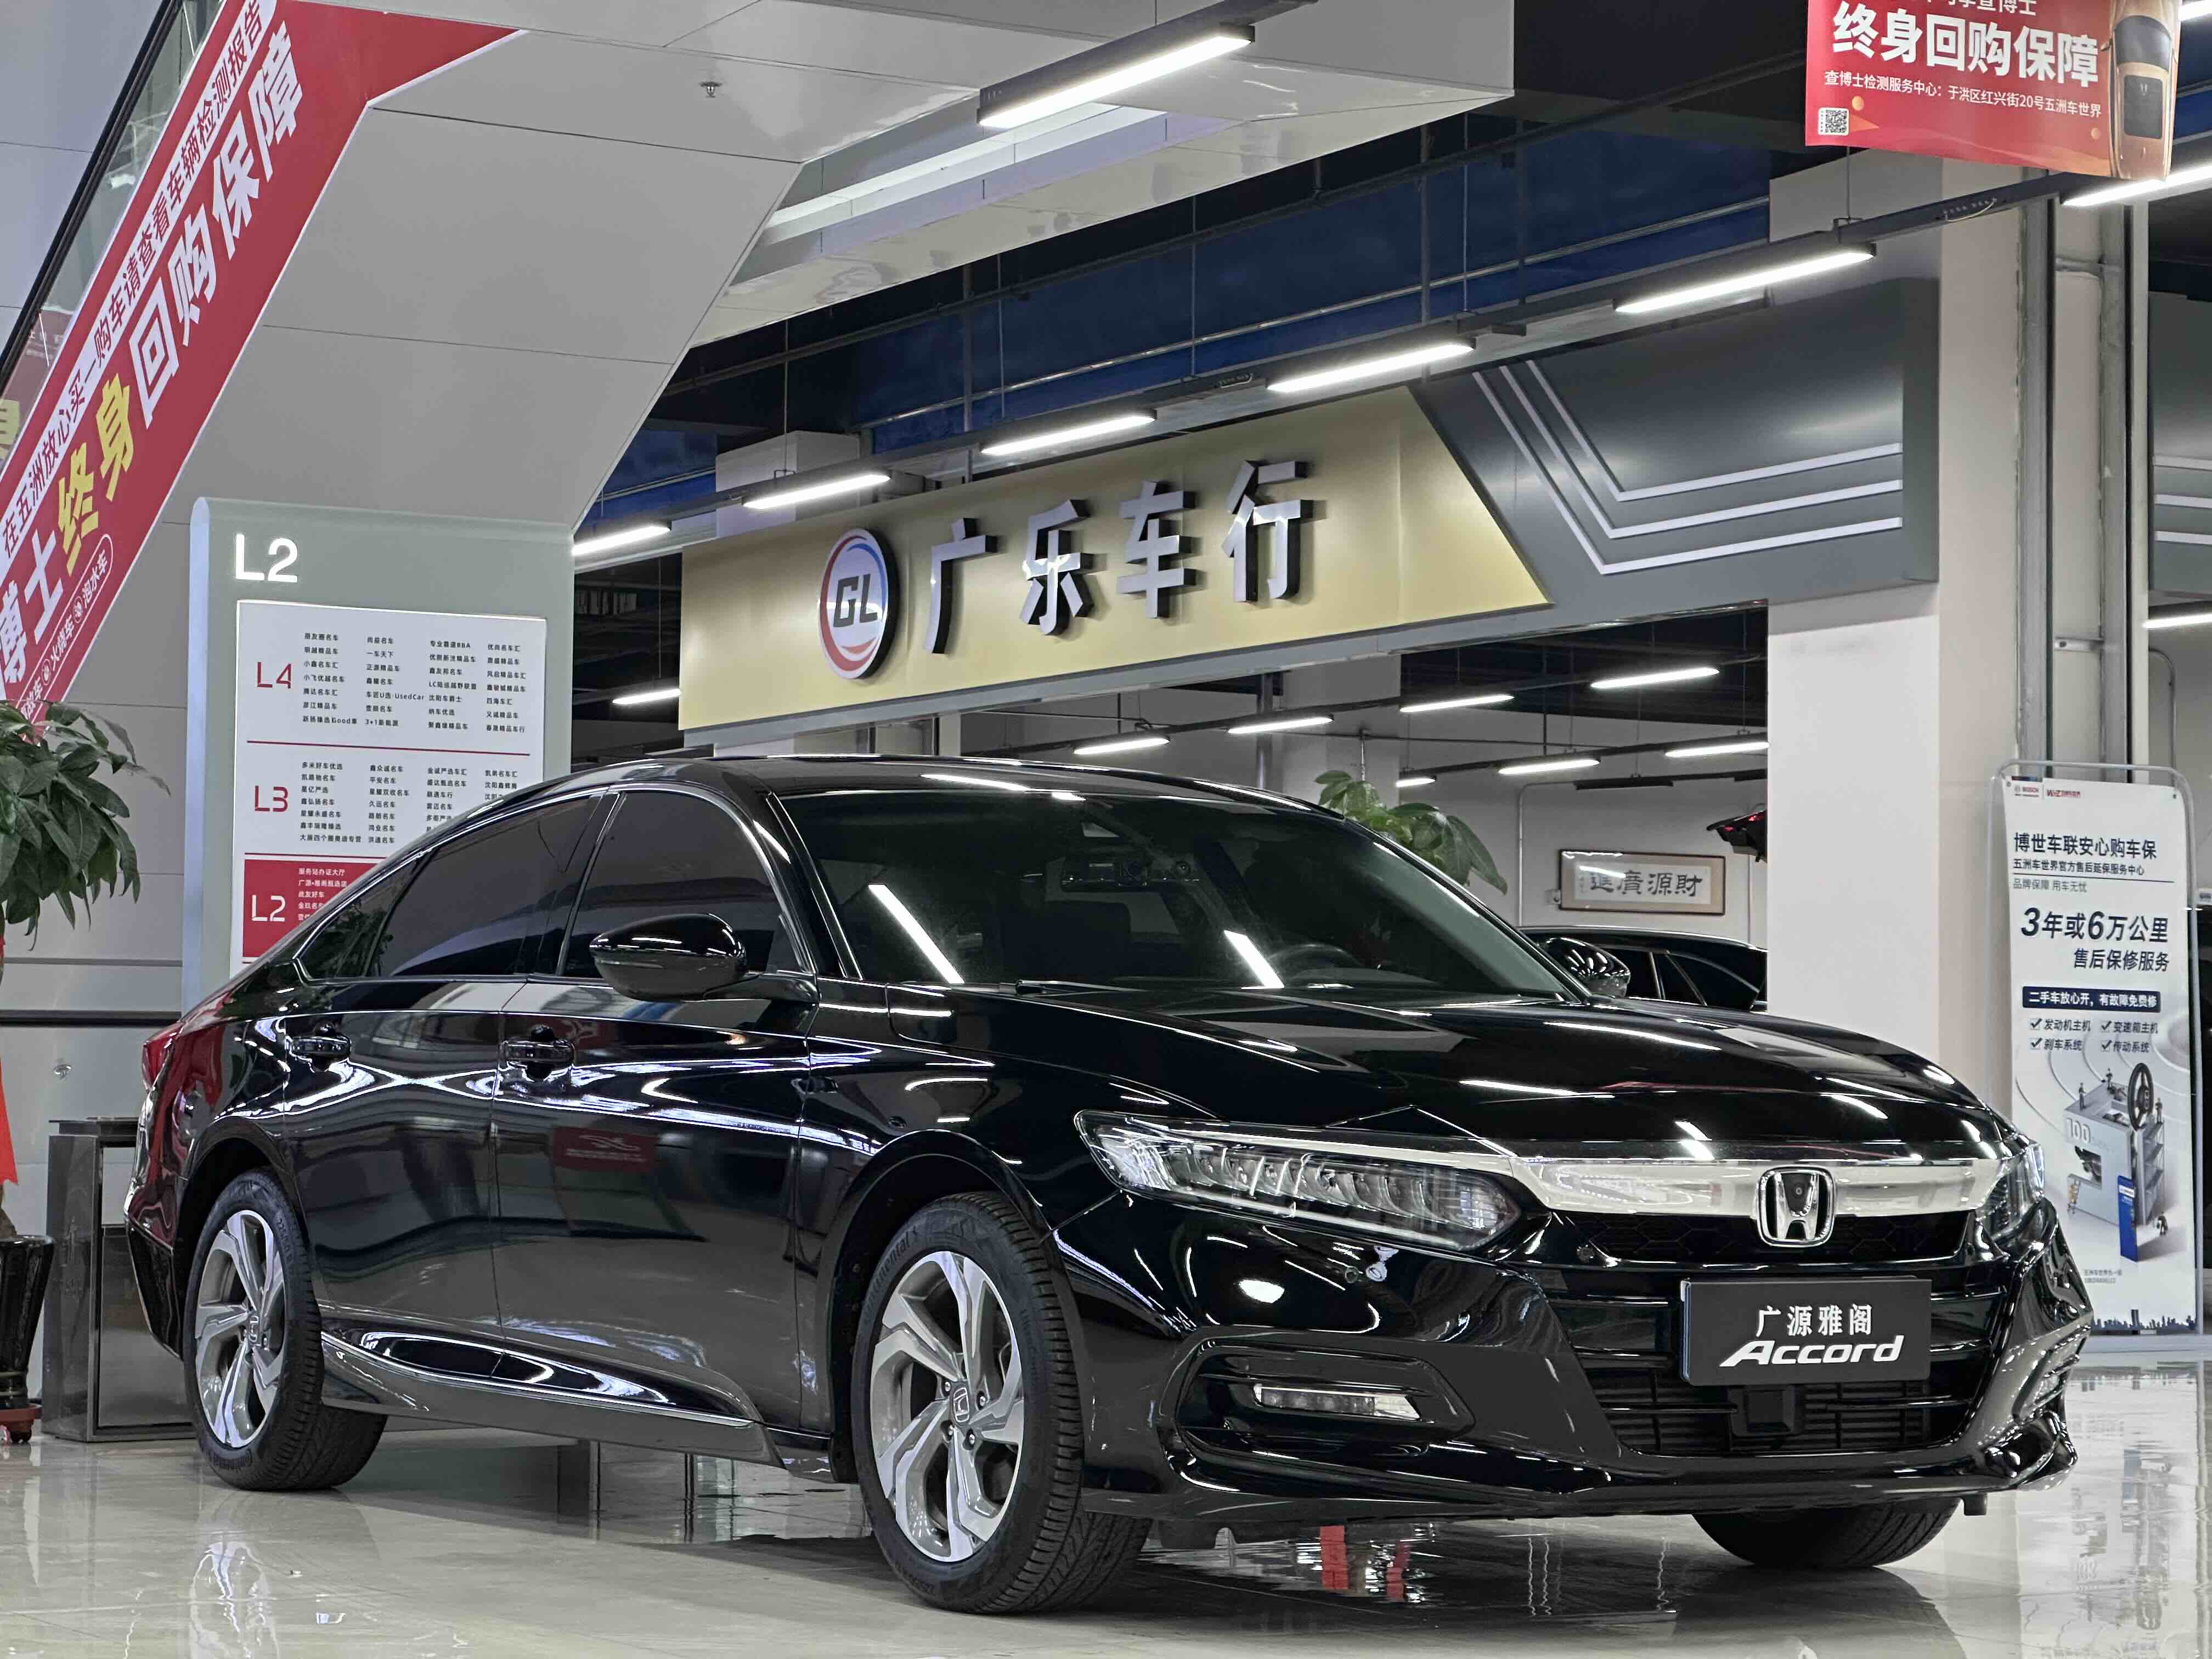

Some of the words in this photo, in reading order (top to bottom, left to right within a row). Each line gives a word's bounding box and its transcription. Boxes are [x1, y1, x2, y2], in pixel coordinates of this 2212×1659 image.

[1833, 1, 2098, 87] 终身回购保障
[235, 533, 298, 583] L2
[923, 460, 1308, 654] 广乐车行
[832, 573, 878, 628] GL
[366, 650, 393, 658] 一车天下
[257, 662, 291, 689] L4
[255, 786, 288, 812] L3
[2014, 832, 2157, 860] 博世车联安心购车保
[2013, 859, 2145, 876] 五洲车世界官方售后延保服务中心
[2013, 878, 2049, 891] 品牌保障
[252, 895, 285, 922] L2
[2021, 907, 2168, 943] 3年或6万公里
[2074, 948, 2170, 972] 售后保修服务
[2044, 1019, 2091, 1032] 发动机主机
[2113, 1022, 2158, 1034] 变速箱主机
[2044, 1038, 2083, 1051] 刹车系统
[2113, 1041, 2150, 1053] 传动系统
[1756, 1304, 1872, 1337] 广源雅阁
[1719, 1335, 1904, 1367] Accord
